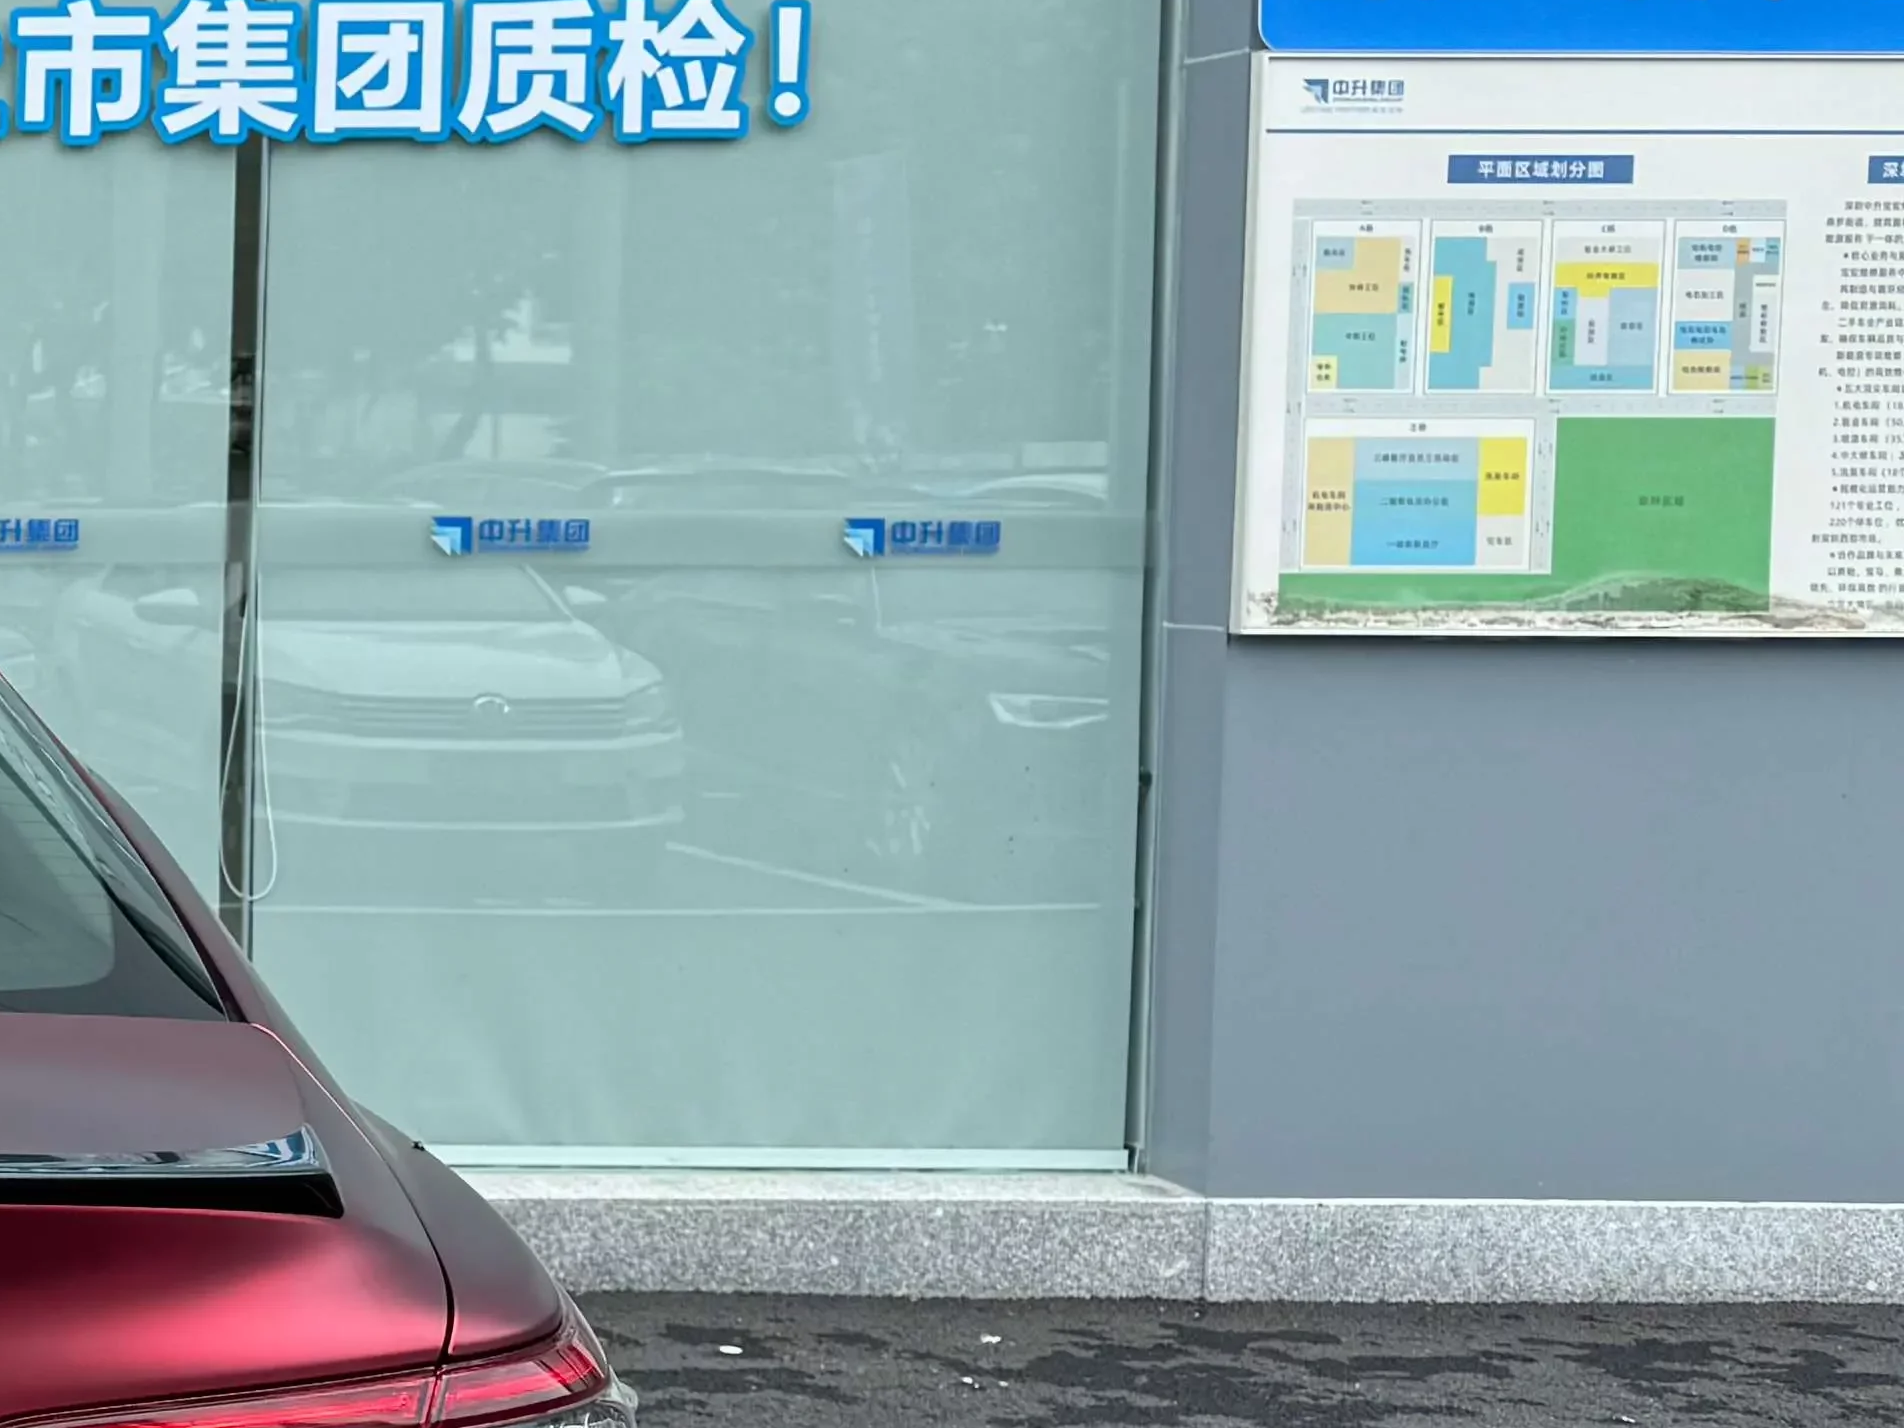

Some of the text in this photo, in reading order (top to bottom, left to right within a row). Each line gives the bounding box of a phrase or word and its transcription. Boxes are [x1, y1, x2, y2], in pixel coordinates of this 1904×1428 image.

[1333, 79, 1404, 96] 中升集团
[1477, 160, 1605, 179] 平面区域划分图
[1883, 162, 1904, 178] 深
[480, 519, 590, 542] 中升集团
[891, 521, 1001, 544] 中升集团
